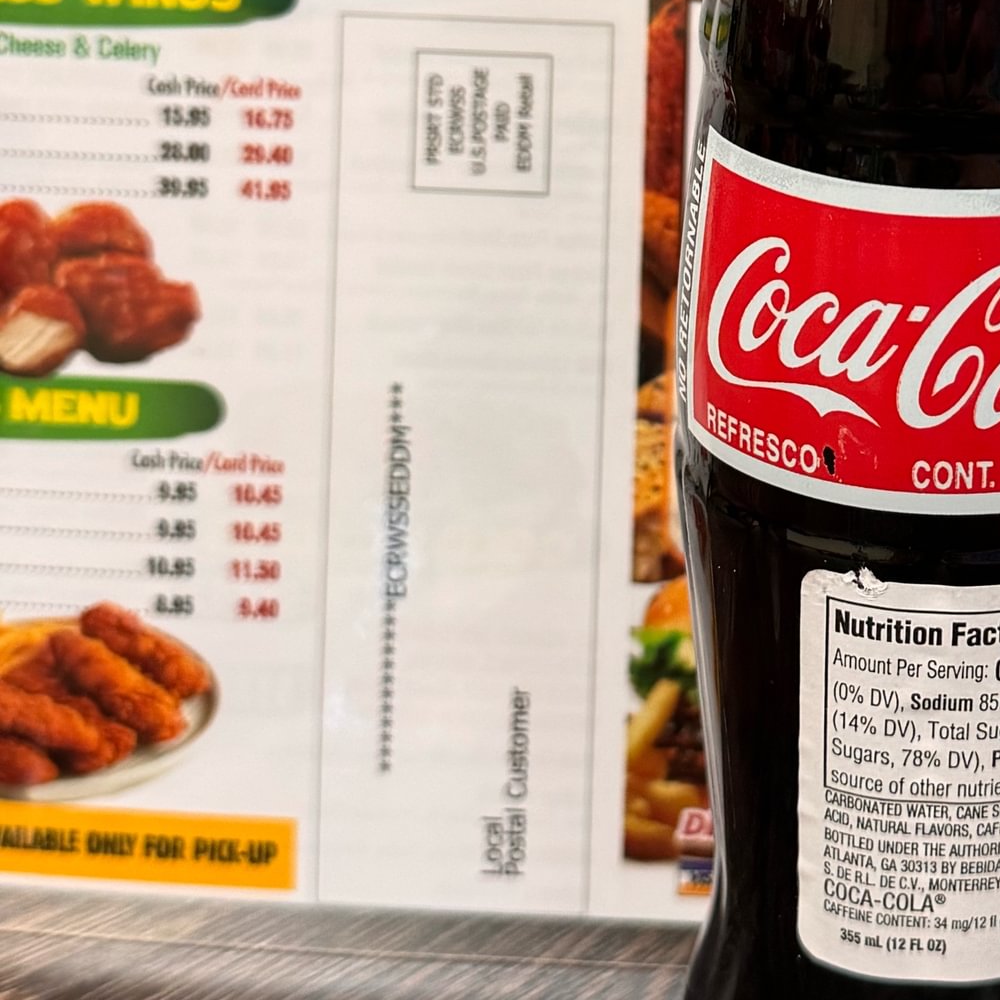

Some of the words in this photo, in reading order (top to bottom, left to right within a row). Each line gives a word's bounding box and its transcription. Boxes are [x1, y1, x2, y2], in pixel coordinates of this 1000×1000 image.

[678, 141, 706, 352] RETORNABLE
[678, 357, 687, 404] NO
[7, 388, 140, 427] MENU
[706, 401, 821, 474] REFRESCO
[912, 459, 996, 490] CONT.
[835, 608, 942, 645] Nutrition
[833, 647, 892, 675] Amount
[897, 659, 922, 678] Per
[927, 659, 989, 683] Serving:
[833, 681, 864, 704] (0%
[870, 688, 904, 713] DV),
[910, 693, 973, 712] Sodium
[506, 686, 531, 799] Customer
[832, 709, 877, 735] (14%
[884, 719, 921, 743] DV),
[928, 720, 970, 740] Total
[832, 737, 895, 769] Sugars,
[901, 749, 941, 768] 78%
[948, 751, 985, 774] DV),
[831, 770, 883, 793] source
[889, 777, 906, 795] of
[909, 779, 952, 798] other
[824, 789, 902, 816] CARBONATED
[907, 803, 952, 820] WATER,
[956, 805, 989, 820] CANE
[504, 807, 527, 876] Postal
[824, 808, 853, 828] ACID,
[856, 817, 911, 835] NATURAL
[915, 823, 972, 840] FLAVORS,
[824, 827, 874, 851] BOTTLED
[878, 840, 919, 856] UNDER
[923, 842, 946, 857] THE
[86, 830, 137, 856] ONLY
[143, 834, 186, 859] FOR
[194, 837, 279, 866] PICK-UP
[480, 815, 503, 875] Local
[823, 898, 872, 924] CAFFEINE
[875, 912, 931, 929] CONTENT:
[840, 928, 861, 944] 355
[865, 936, 882, 948] mL
[886, 936, 906, 951] (12
[910, 938, 924, 951] FL
[927, 939, 947, 955] OZ)
